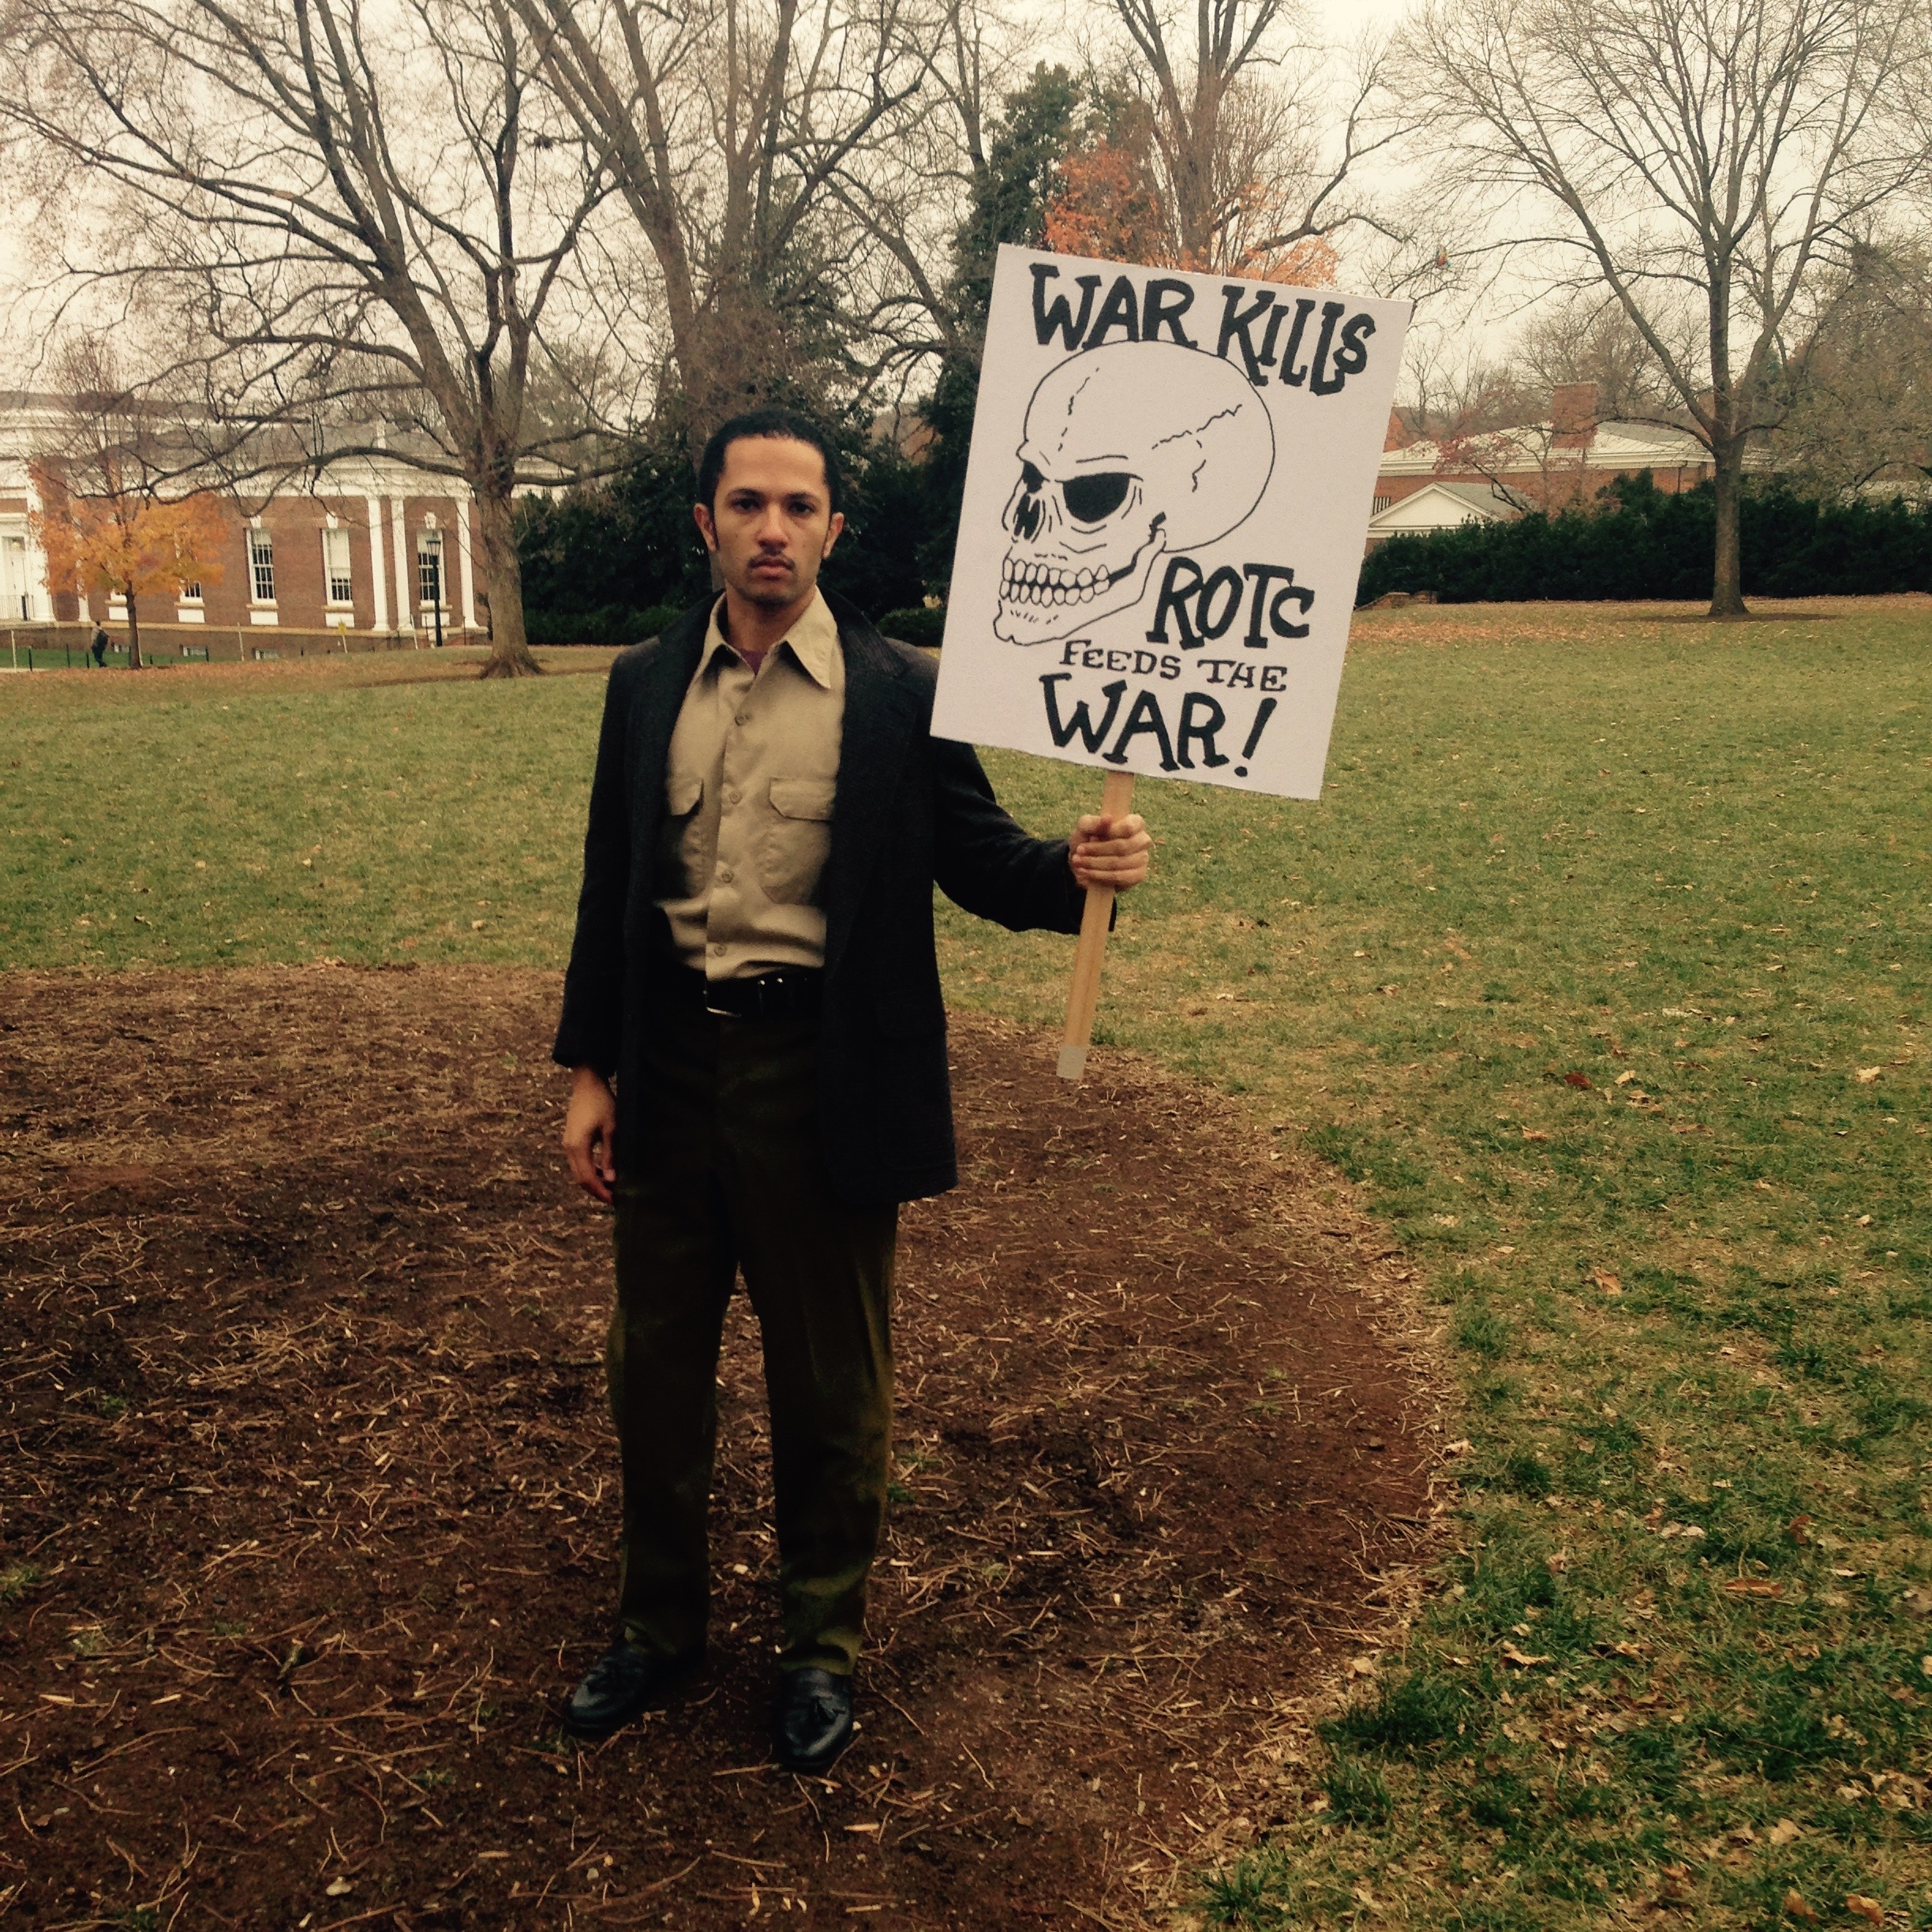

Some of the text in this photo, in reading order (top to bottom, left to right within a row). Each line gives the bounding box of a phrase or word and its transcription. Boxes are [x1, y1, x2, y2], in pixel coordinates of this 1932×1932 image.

[1028, 262, 1376, 397] WAR KILLS
[1145, 556, 1316, 650] ROTC
[1059, 639, 1288, 692] FEEDS THE
[1038, 672, 1278, 777] WAR!
